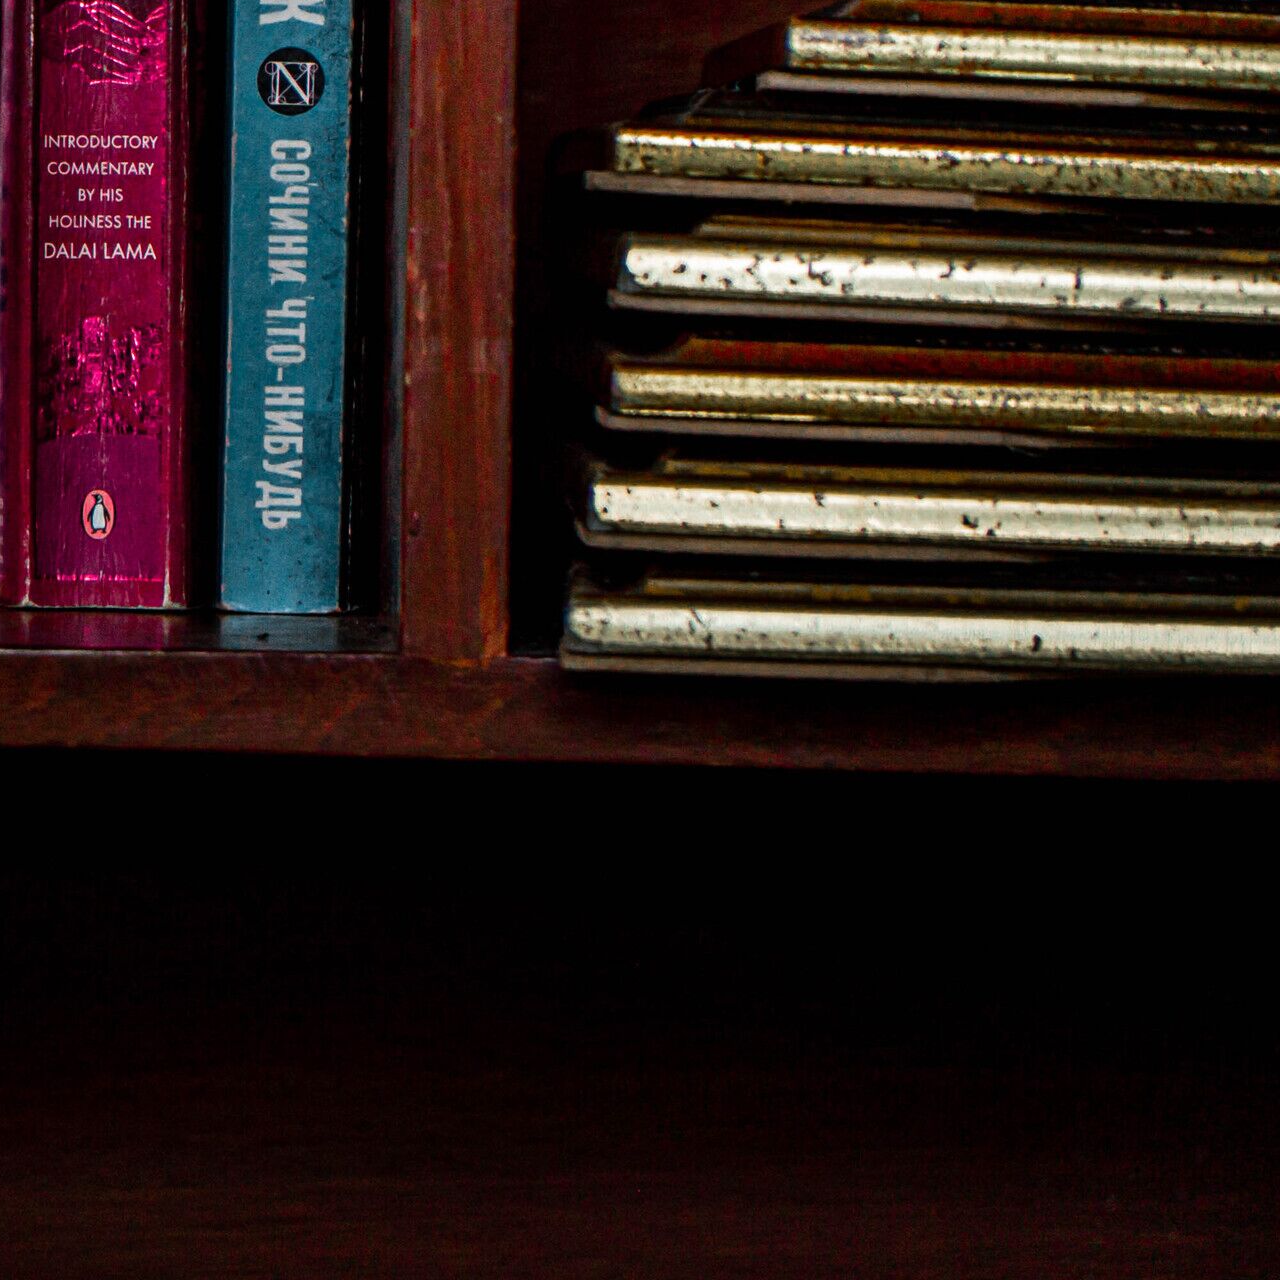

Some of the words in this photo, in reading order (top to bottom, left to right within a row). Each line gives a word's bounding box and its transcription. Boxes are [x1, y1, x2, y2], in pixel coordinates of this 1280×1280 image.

[44, 134, 158, 150] INTRODUCTORY
[47, 161, 155, 177] COMMENTARY
[78, 188, 95, 203] BY
[99, 188, 124, 203] HIS
[268, 138, 313, 286] СОЧИНИ
[48, 214, 124, 230] HOLINESS
[126, 214, 152, 230] THE
[43, 241, 97, 260] DALAI
[102, 241, 157, 260] LAMA
[255, 295, 316, 531] ЧТО-НИБУДЬ
